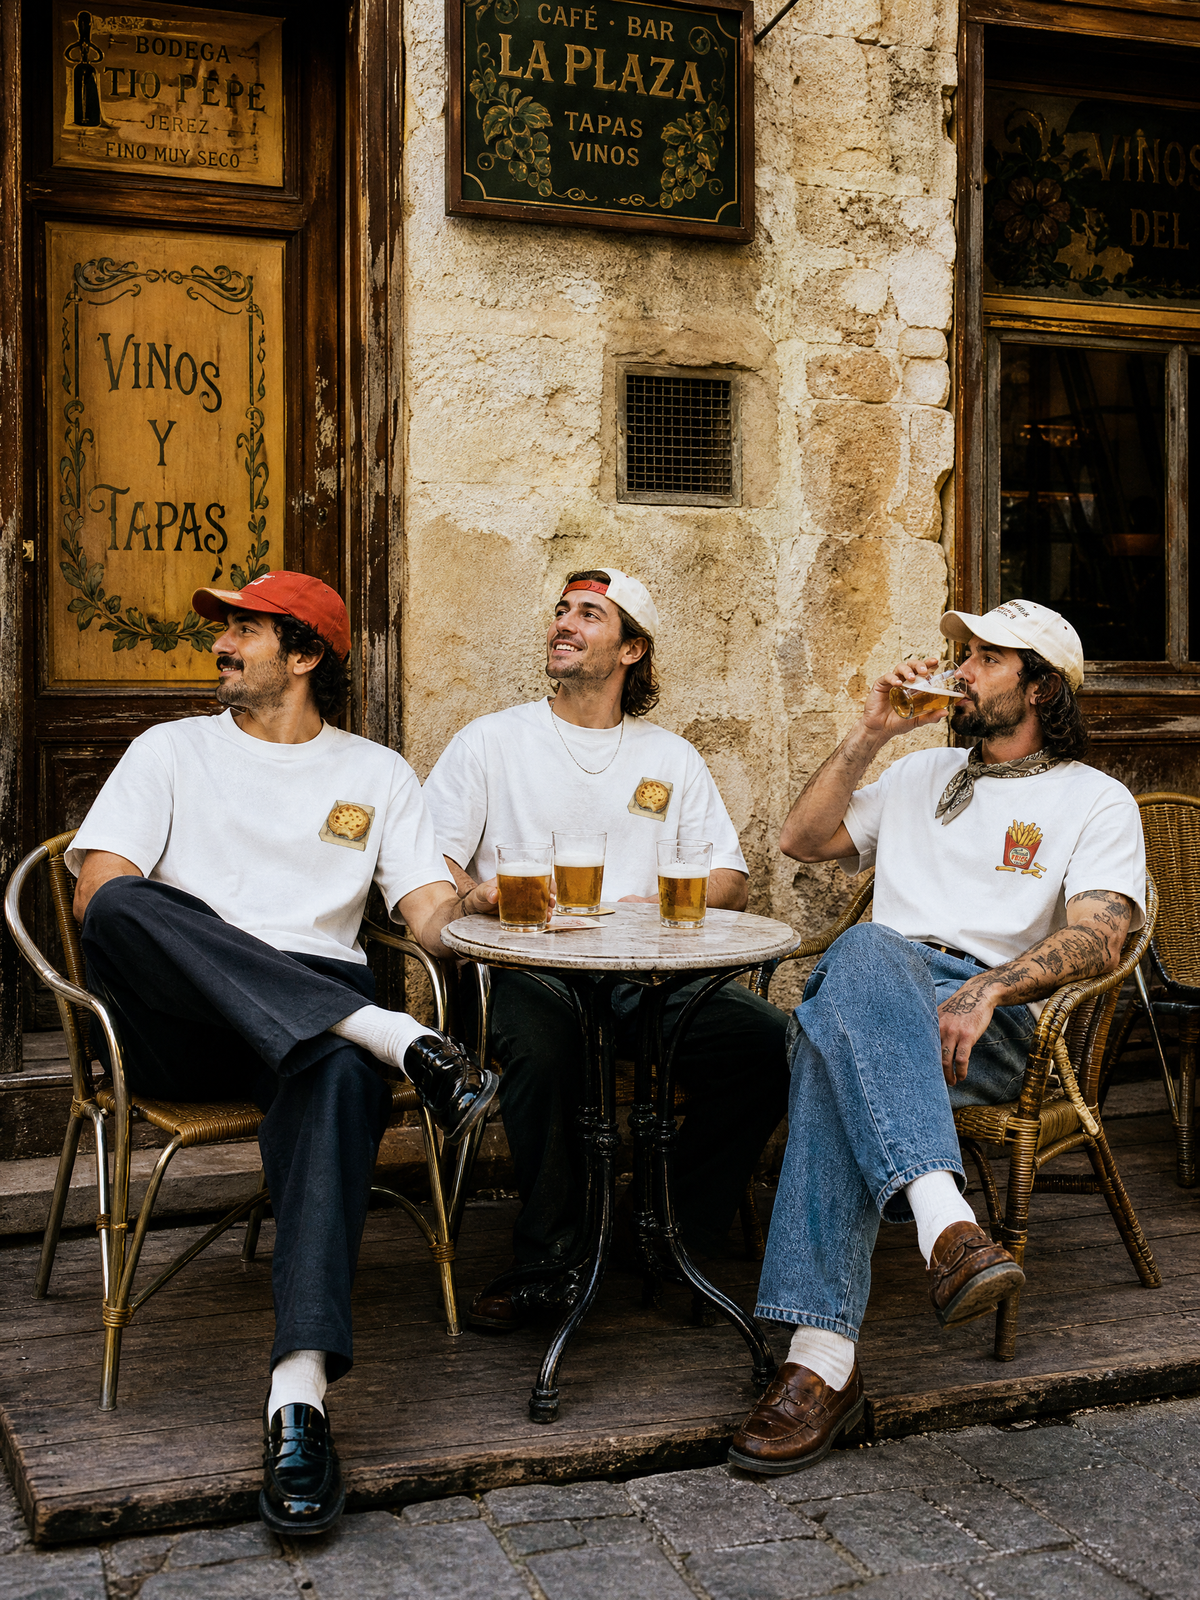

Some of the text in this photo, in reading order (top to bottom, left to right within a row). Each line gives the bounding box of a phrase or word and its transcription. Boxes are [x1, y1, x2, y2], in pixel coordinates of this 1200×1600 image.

[537, 3, 674, 42] CAFÉ BAR
[135, 35, 231, 64] BODEGA
[498, 33, 706, 105] LA PLAZA
[104, 66, 266, 112] TIO PEPE
[145, 115, 209, 135] JEREZ
[564, 111, 643, 139] TAPAS
[105, 142, 240, 168] FINO MUY SECO
[569, 141, 640, 167] VINOS
[1130, 207, 1190, 251] DEL
[97, 332, 222, 413] VINOS
[147, 419, 177, 466] Y
[87, 483, 228, 556] TAPAS
